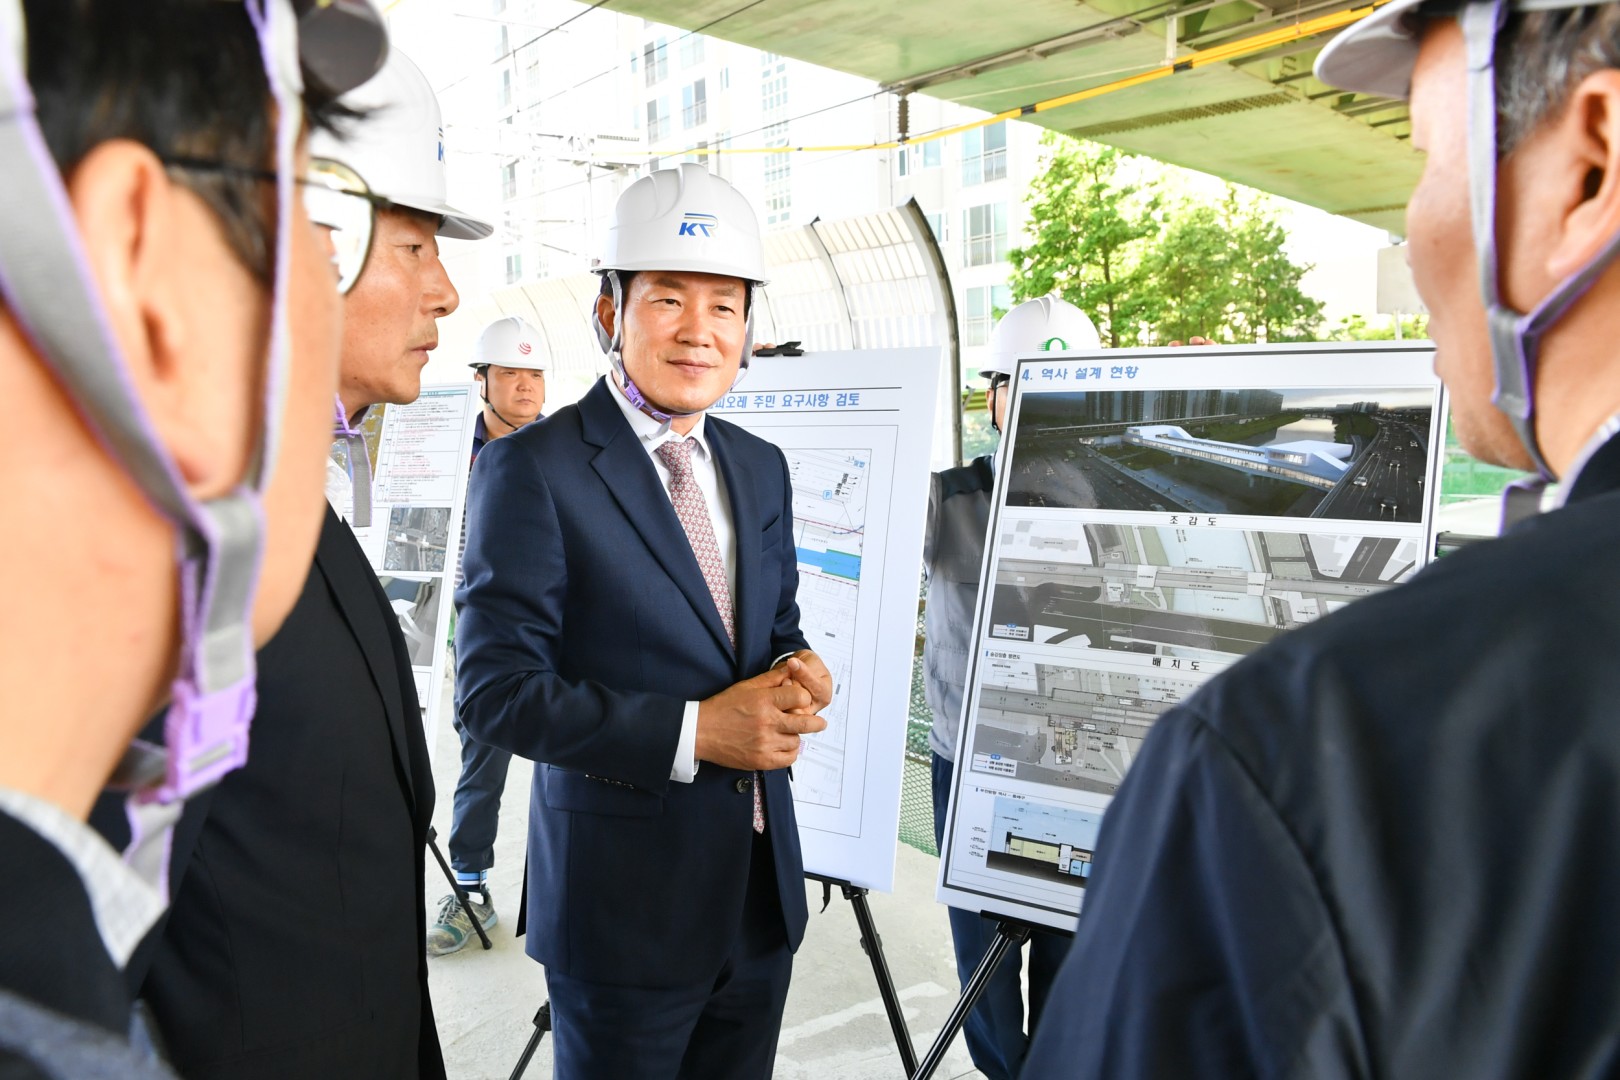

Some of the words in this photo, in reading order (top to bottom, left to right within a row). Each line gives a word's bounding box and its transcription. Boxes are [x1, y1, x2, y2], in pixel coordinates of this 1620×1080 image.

[678, 212, 719, 238] KR
[1021, 369, 1033, 381] 4.
[1041, 368, 1068, 380] 역사
[1075, 366, 1102, 380] 설계
[1110, 365, 1139, 379] 현황
[710, 396, 748, 409] 피오레
[753, 395, 776, 408] 주민
[782, 393, 829, 408] 요구사항
[836, 392, 860, 407] 검토
